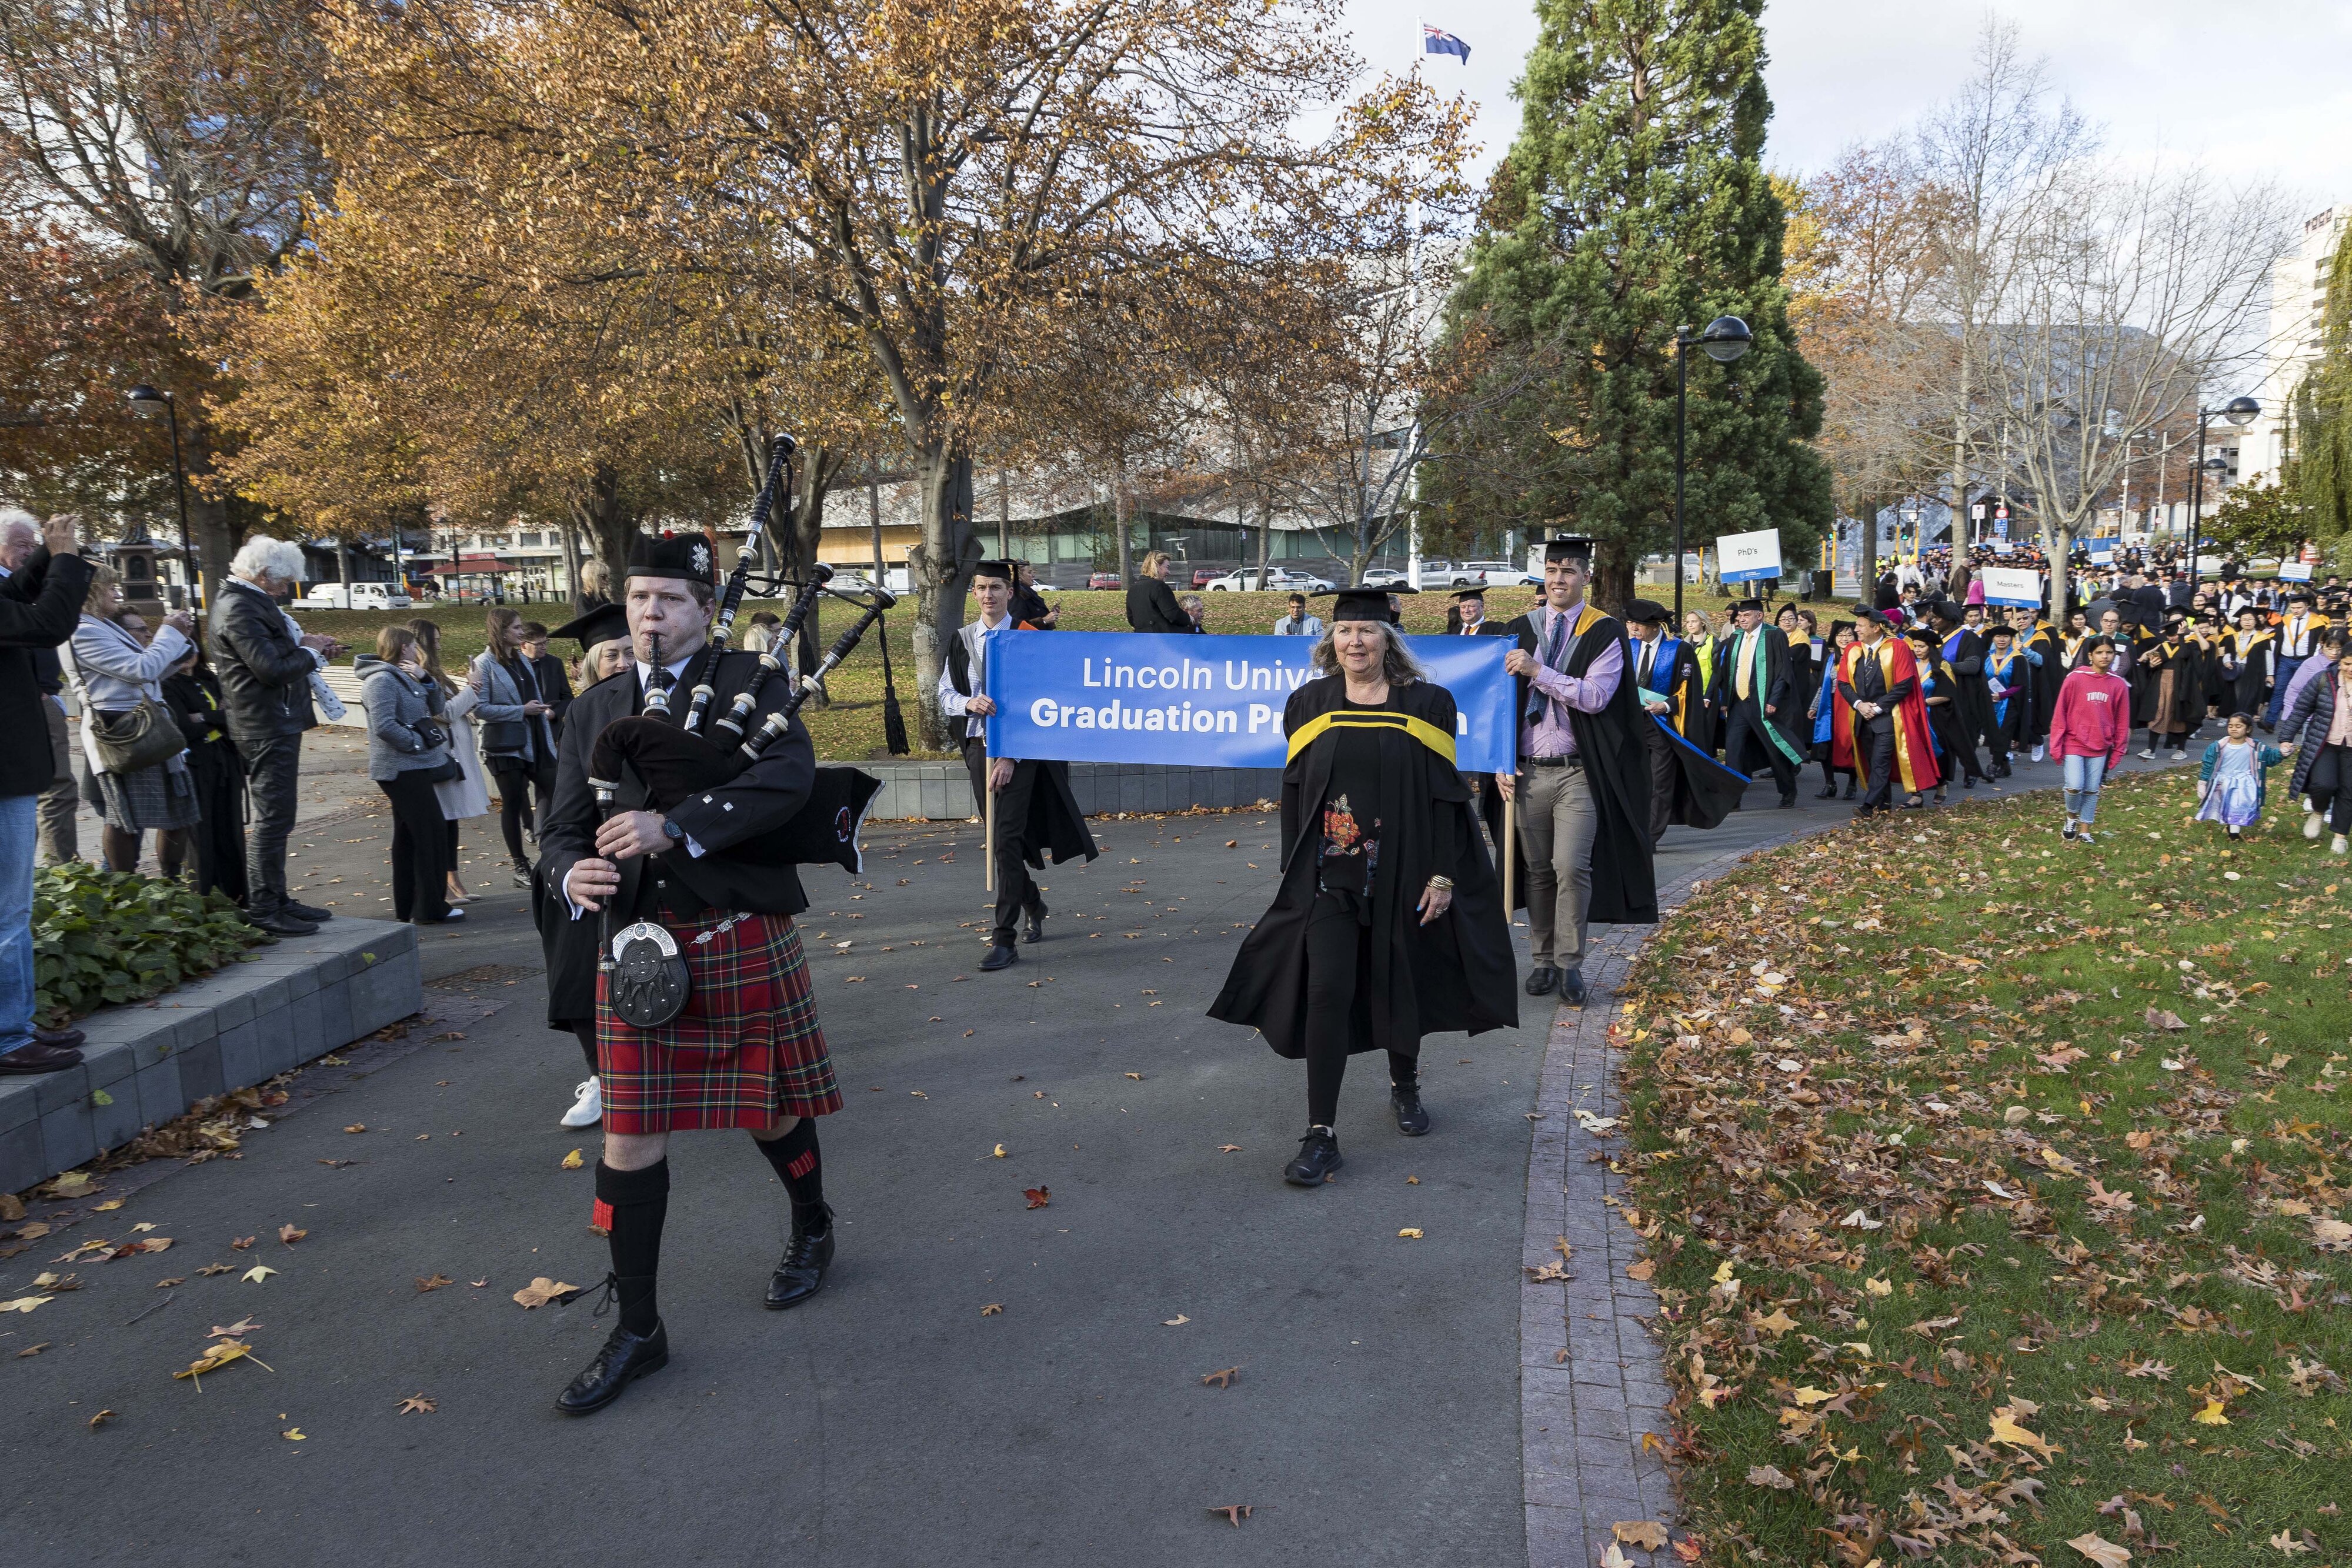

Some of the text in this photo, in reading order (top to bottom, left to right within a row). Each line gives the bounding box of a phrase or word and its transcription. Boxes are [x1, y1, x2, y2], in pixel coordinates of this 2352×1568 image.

[1737, 548, 1758, 556] PhD's
[1083, 658, 1325, 690] Lincoln Unive
[2086, 692, 2109, 702] TOMMY
[1030, 698, 1237, 733] Graduation
